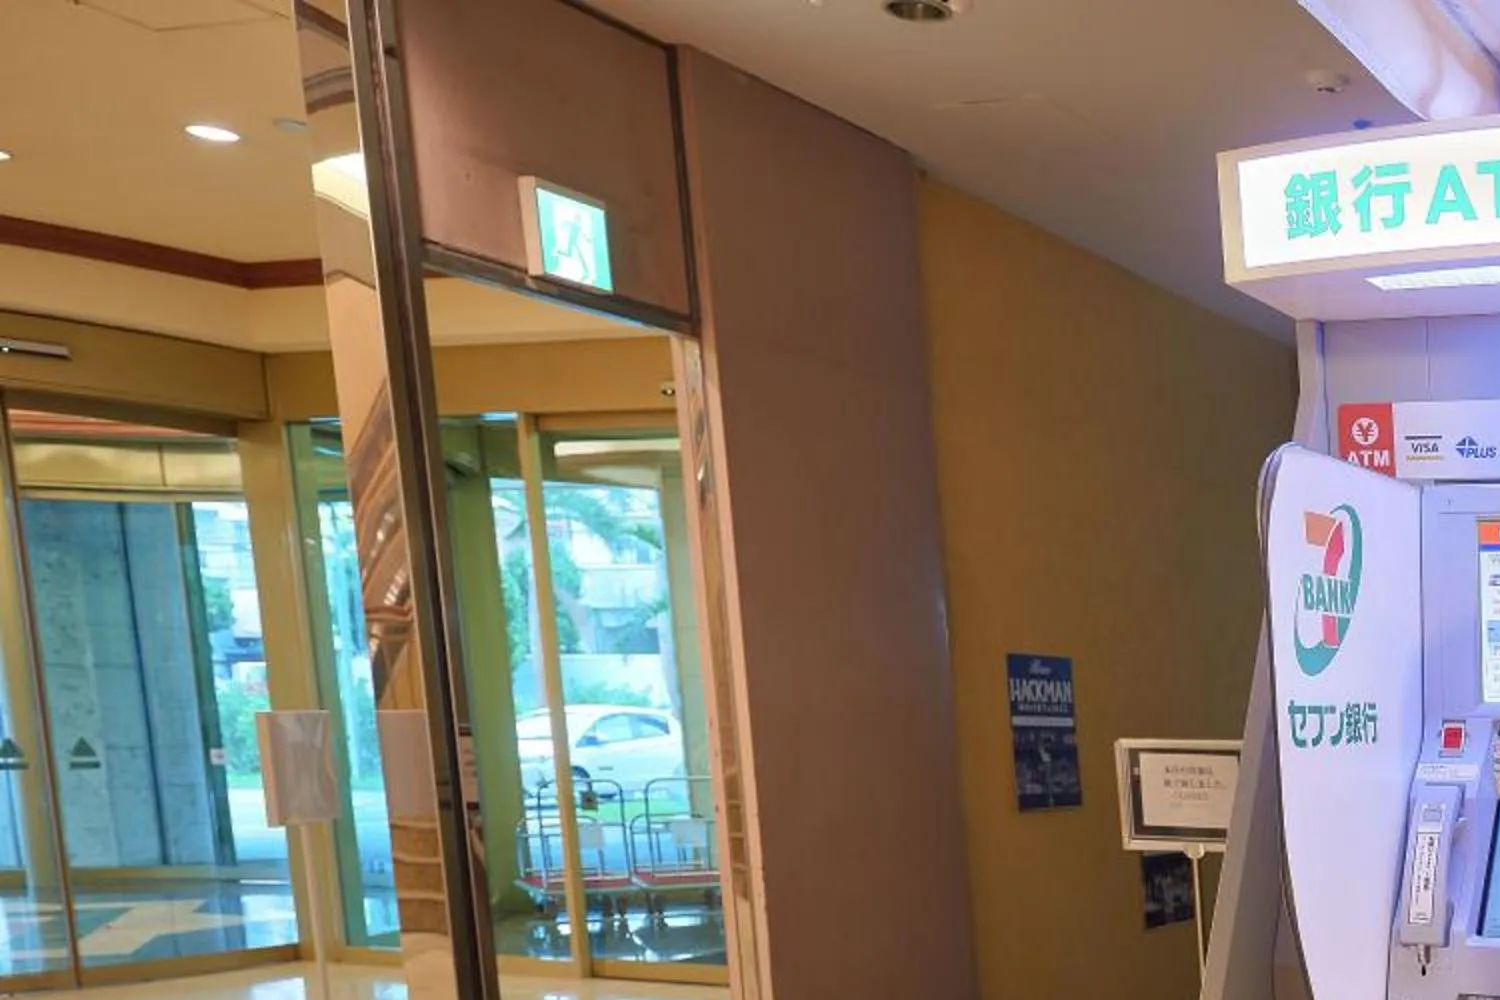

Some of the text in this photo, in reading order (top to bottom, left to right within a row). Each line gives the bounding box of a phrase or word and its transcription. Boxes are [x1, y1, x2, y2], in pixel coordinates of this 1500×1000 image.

[1411, 442, 1440, 454] VISA
[1465, 446, 1497, 459] PLUS
[1347, 450, 1390, 468] ATM
[1302, 573, 1354, 614] BANK
[1009, 678, 1073, 703] HACKMAN
[1287, 701, 1378, 748] セブン銀行
